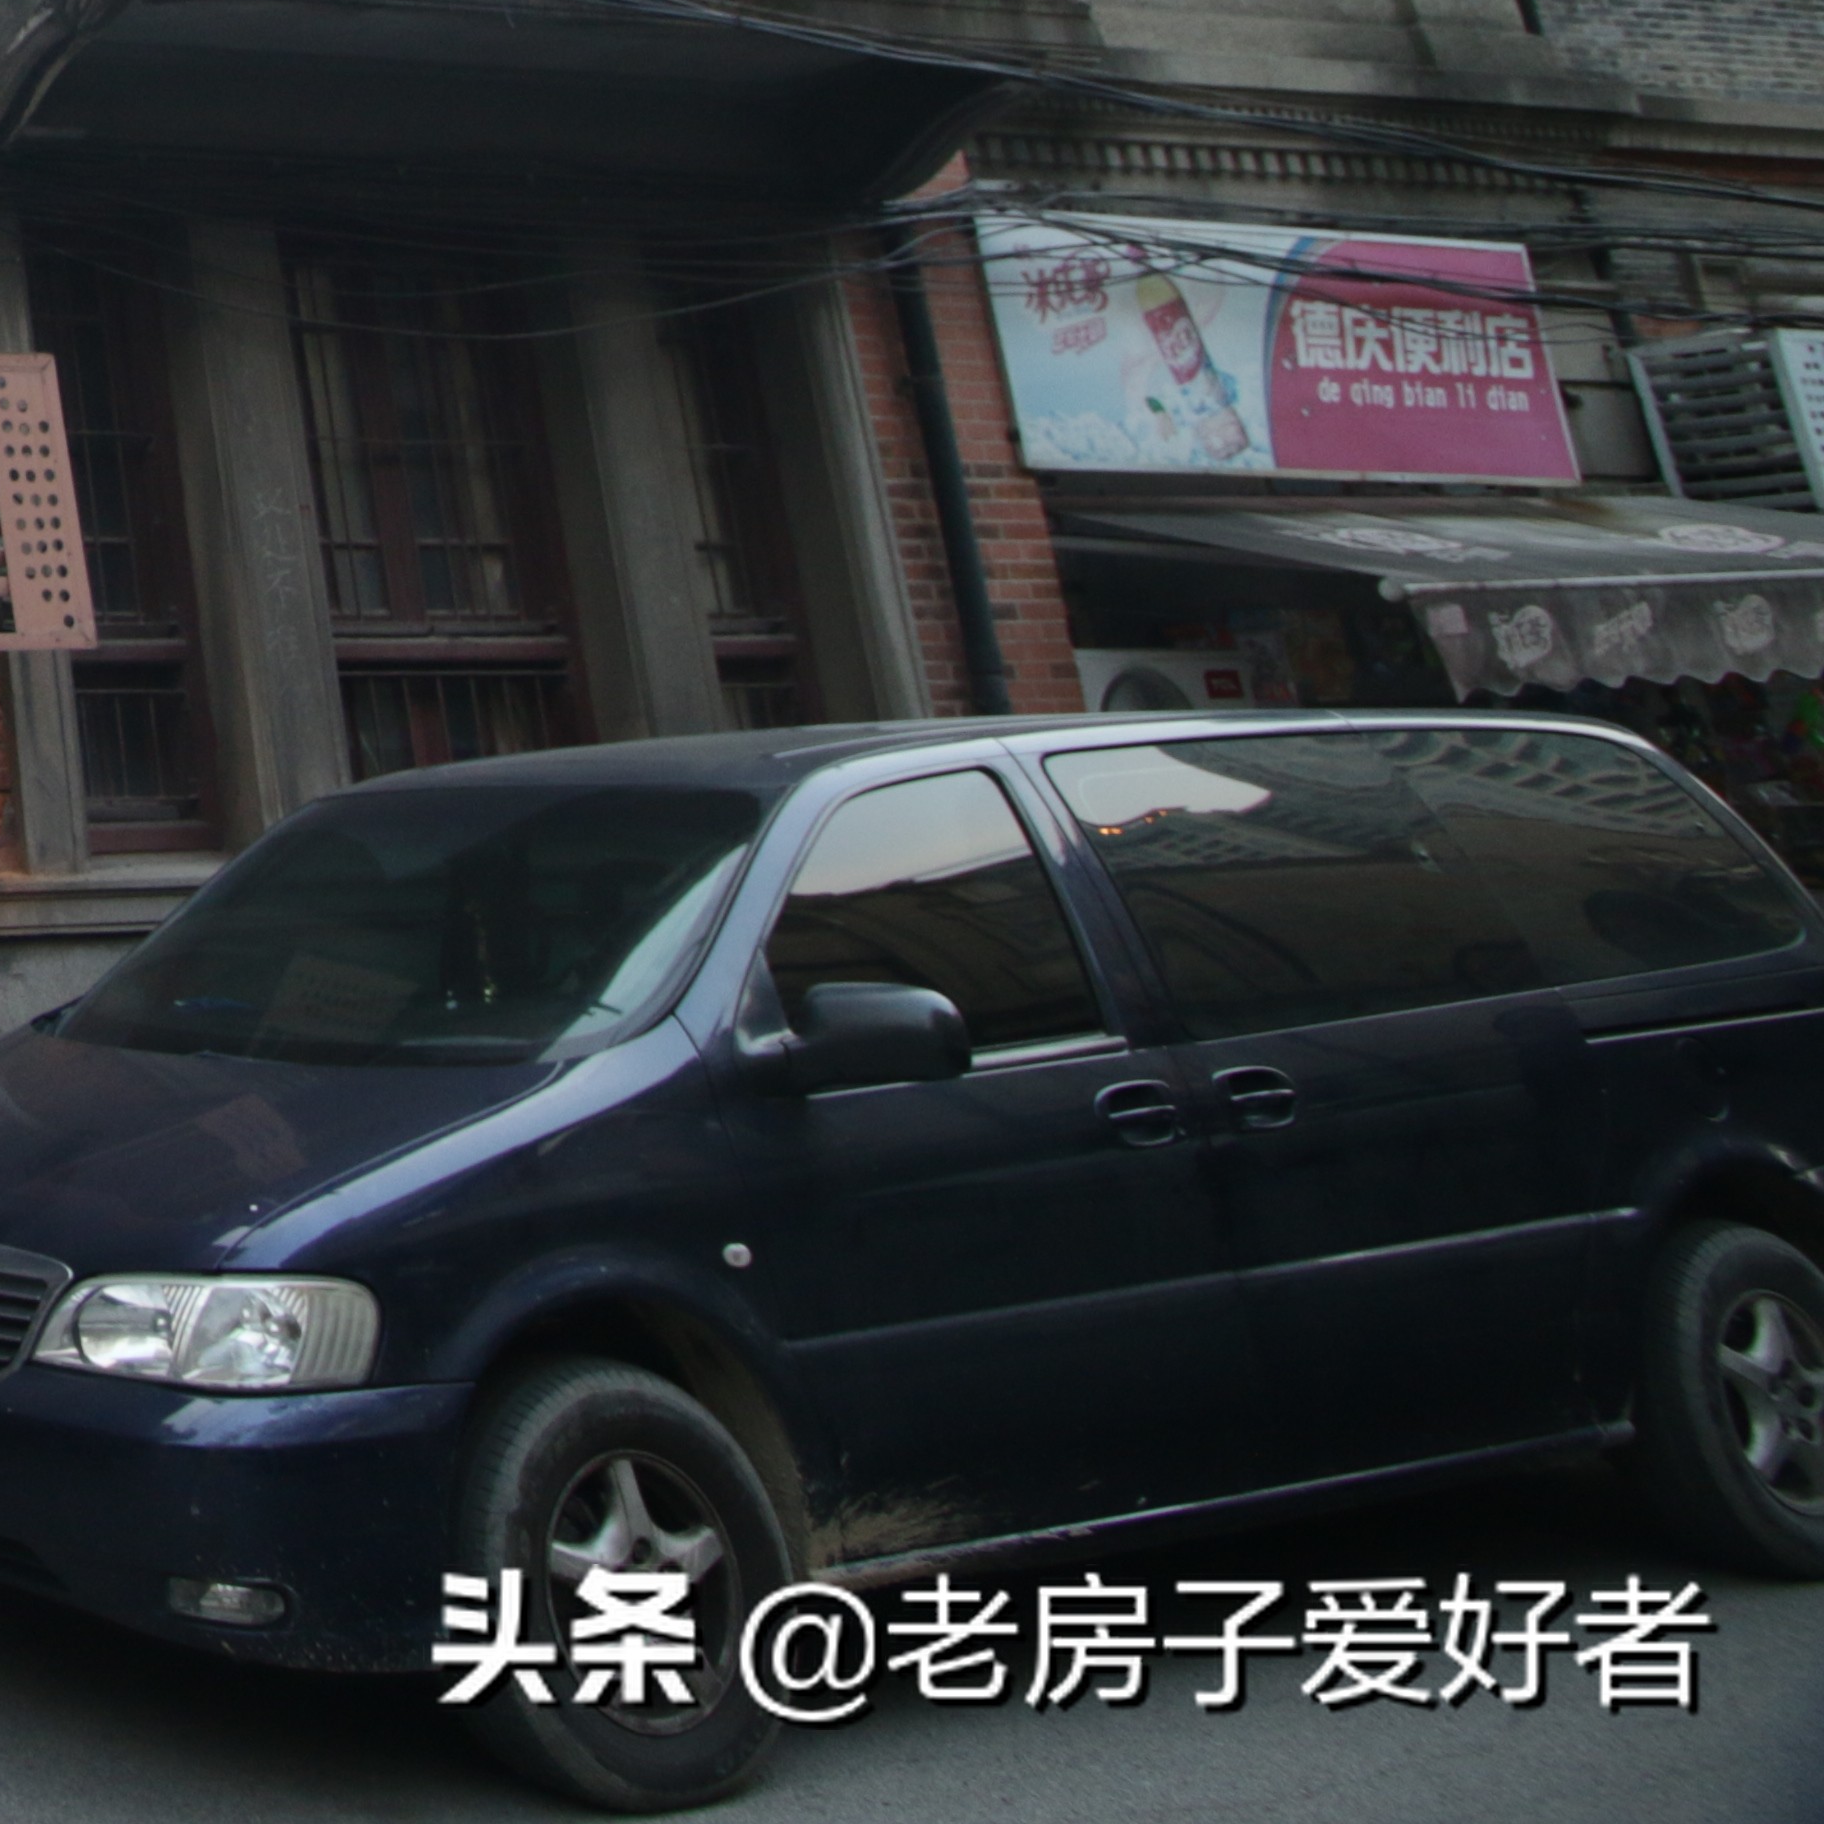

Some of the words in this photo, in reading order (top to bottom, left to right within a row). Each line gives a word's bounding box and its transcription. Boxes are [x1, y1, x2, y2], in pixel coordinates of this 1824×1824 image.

[1290, 300, 1534, 379] 德庆便利店
[1317, 377, 1341, 403] de
[1349, 378, 1395, 409] qing
[1403, 381, 1447, 408] bian
[1455, 383, 1476, 409] li
[1486, 385, 1530, 412] dian
